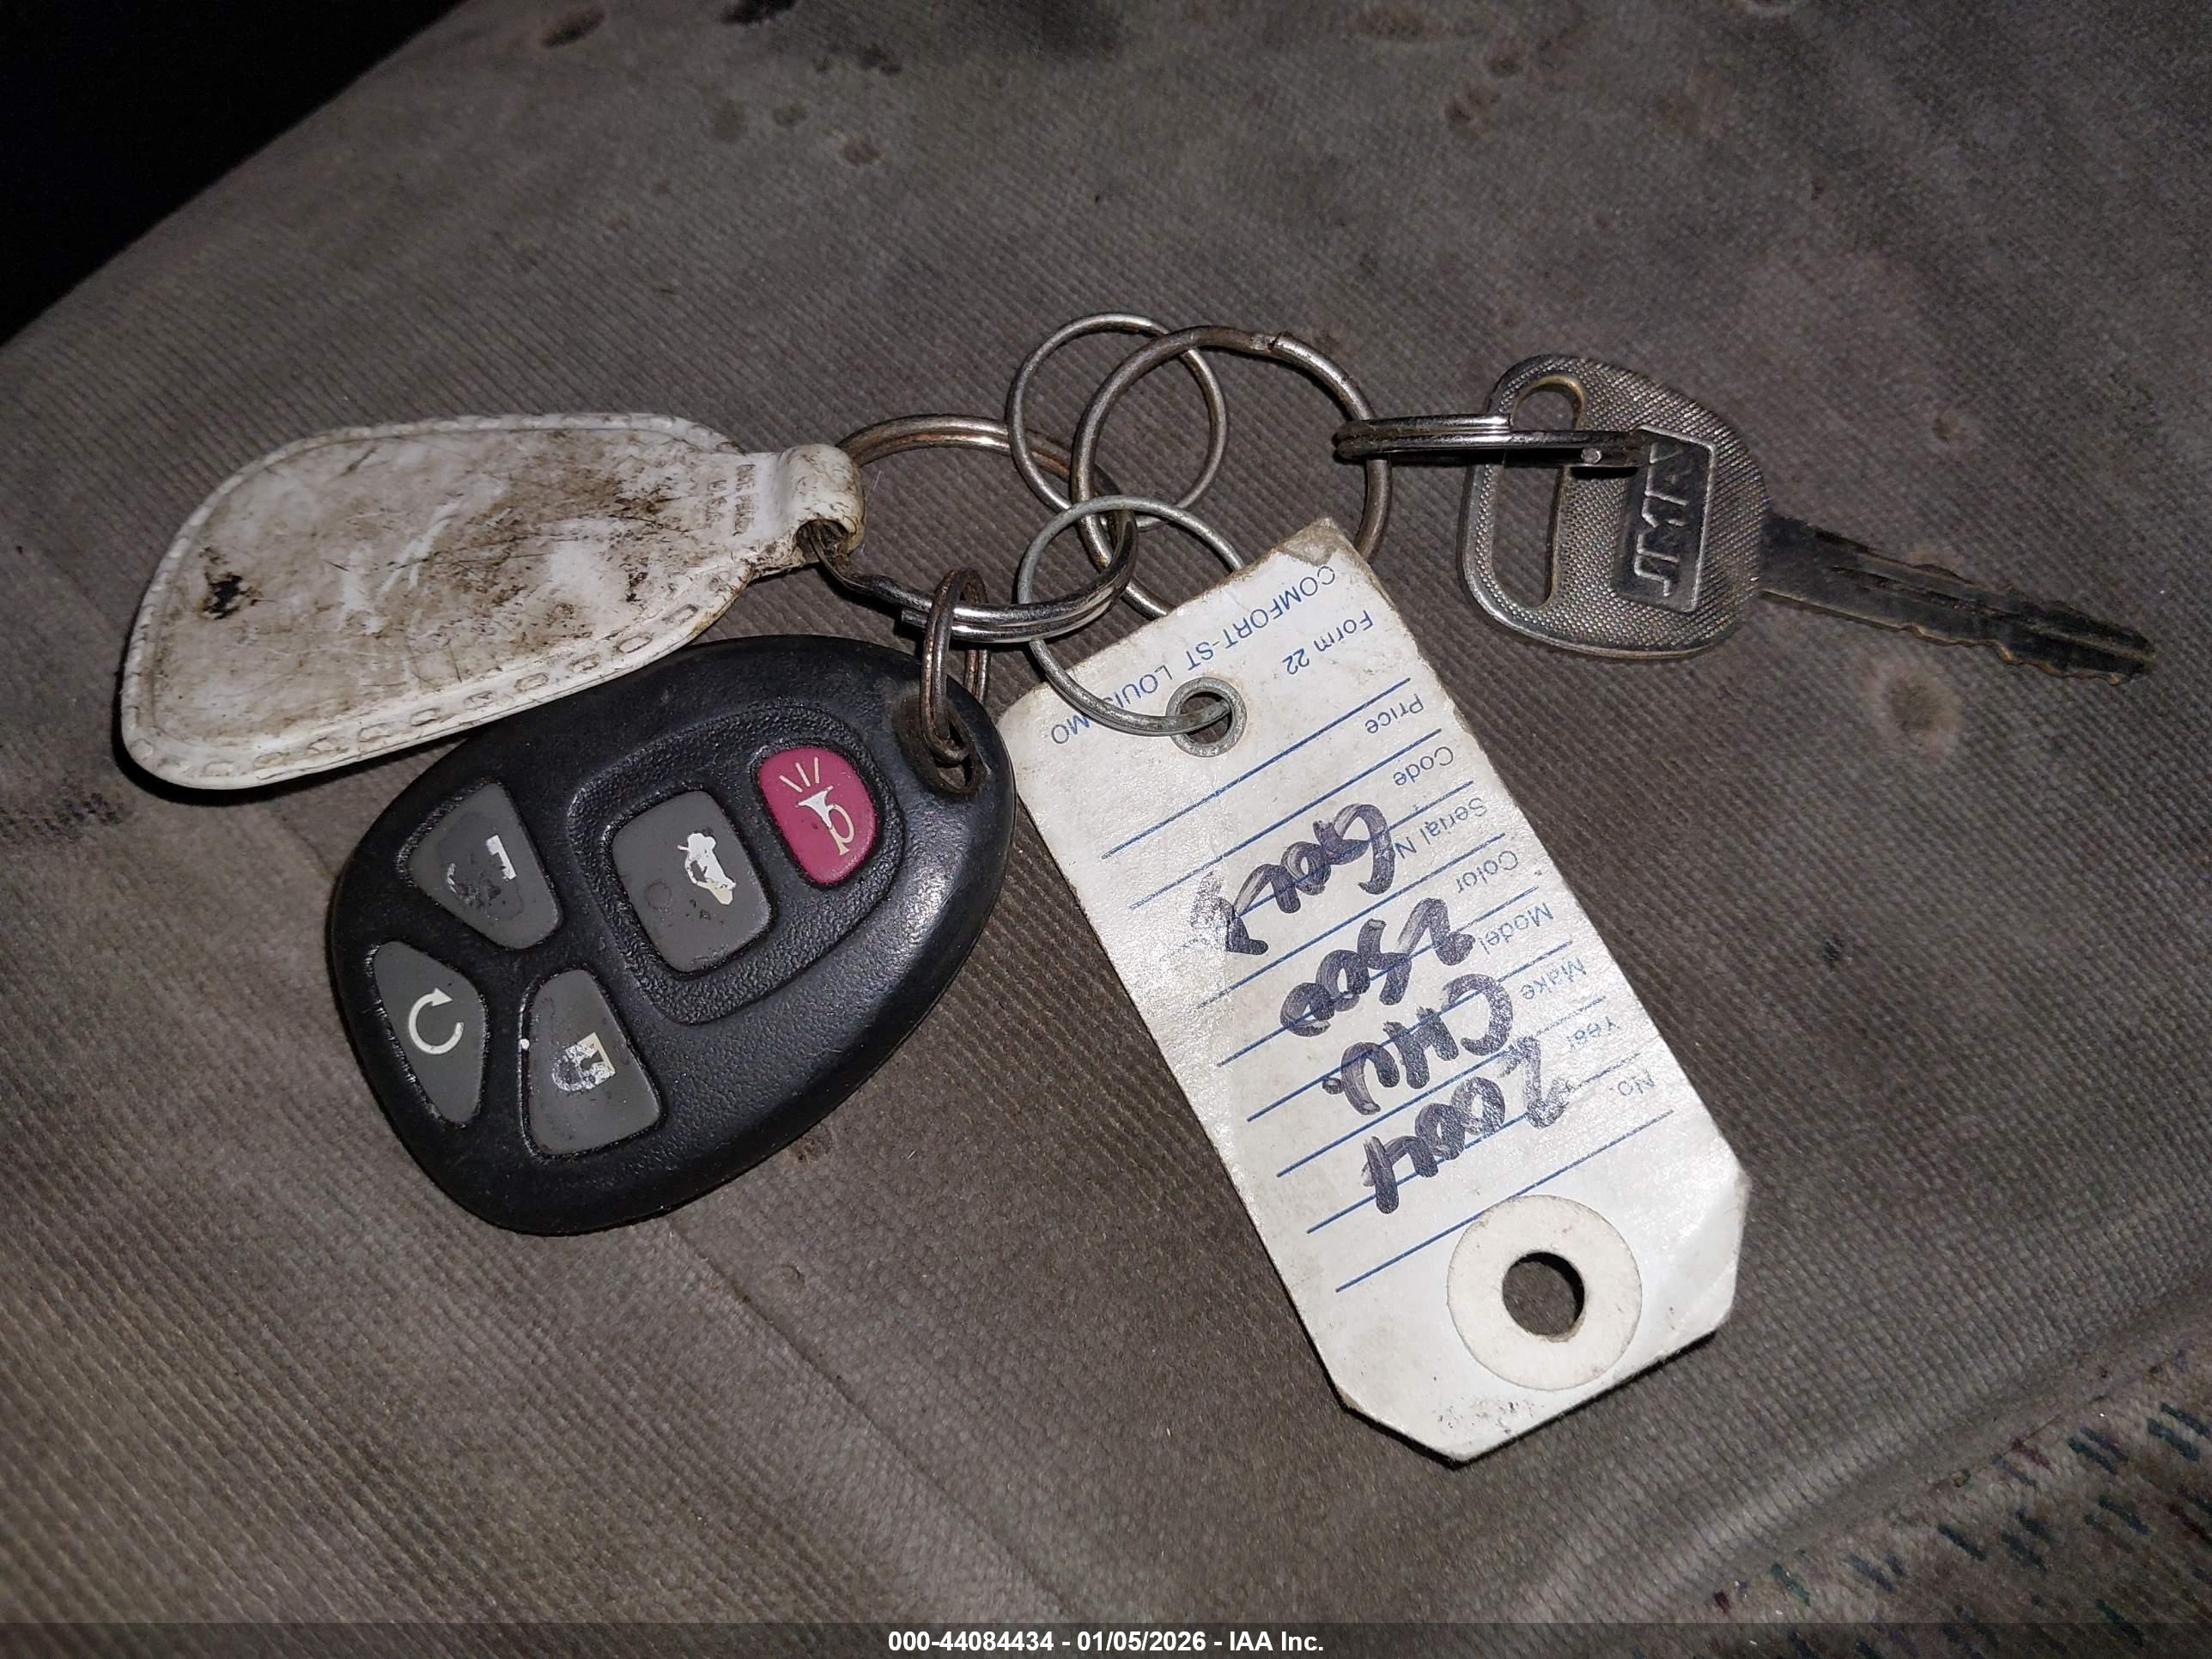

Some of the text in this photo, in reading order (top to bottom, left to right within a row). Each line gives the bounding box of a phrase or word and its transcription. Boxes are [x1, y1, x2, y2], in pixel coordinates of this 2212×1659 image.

[1186, 565, 1336, 671] COMFORT-ST
[1282, 610, 1374, 675] Form 22
[1050, 713, 1091, 744] MO
[1365, 693, 1425, 734] Price
[1393, 745, 1455, 787] Code
[1419, 797, 1487, 845] Serial
[1455, 850, 1518, 894] Color
[1478, 902, 1554, 955] Model
[1279, 897, 1476, 1037] 2500
[1519, 957, 1588, 1000] Make
[1567, 1016, 1622, 1051] Year
[1609, 1070, 1656, 1097] No.
[1361, 1036, 1571, 1214] 2004
